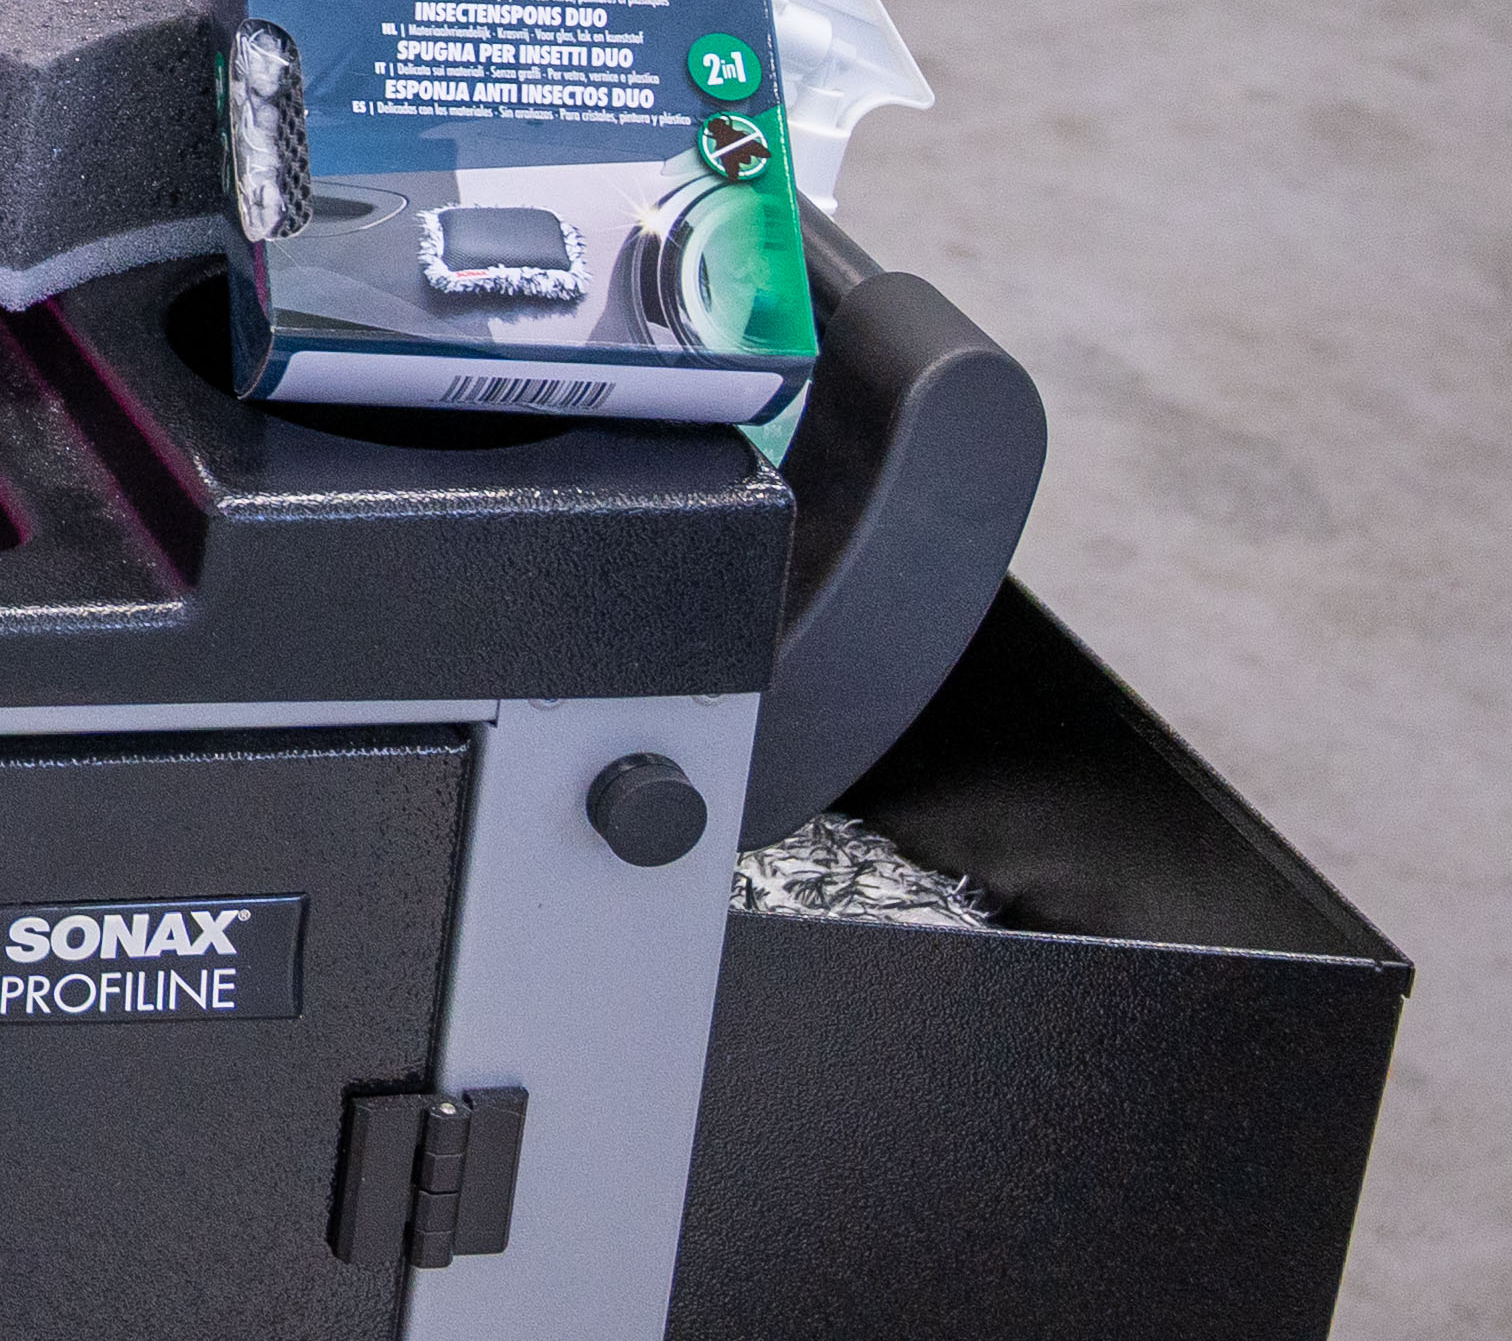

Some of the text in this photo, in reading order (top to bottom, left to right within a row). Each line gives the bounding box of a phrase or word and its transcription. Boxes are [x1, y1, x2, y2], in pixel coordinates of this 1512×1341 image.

[415, 2, 608, 27] INSECTENSPONS DUO
[397, 40, 634, 68] SPUGNA PER INSETTI DUO
[384, 79, 655, 109] ESPONJA ANTI INSECTOS DUO
[5, 910, 237, 963] SONAX
[0, 968, 237, 1015] PROFILINE
